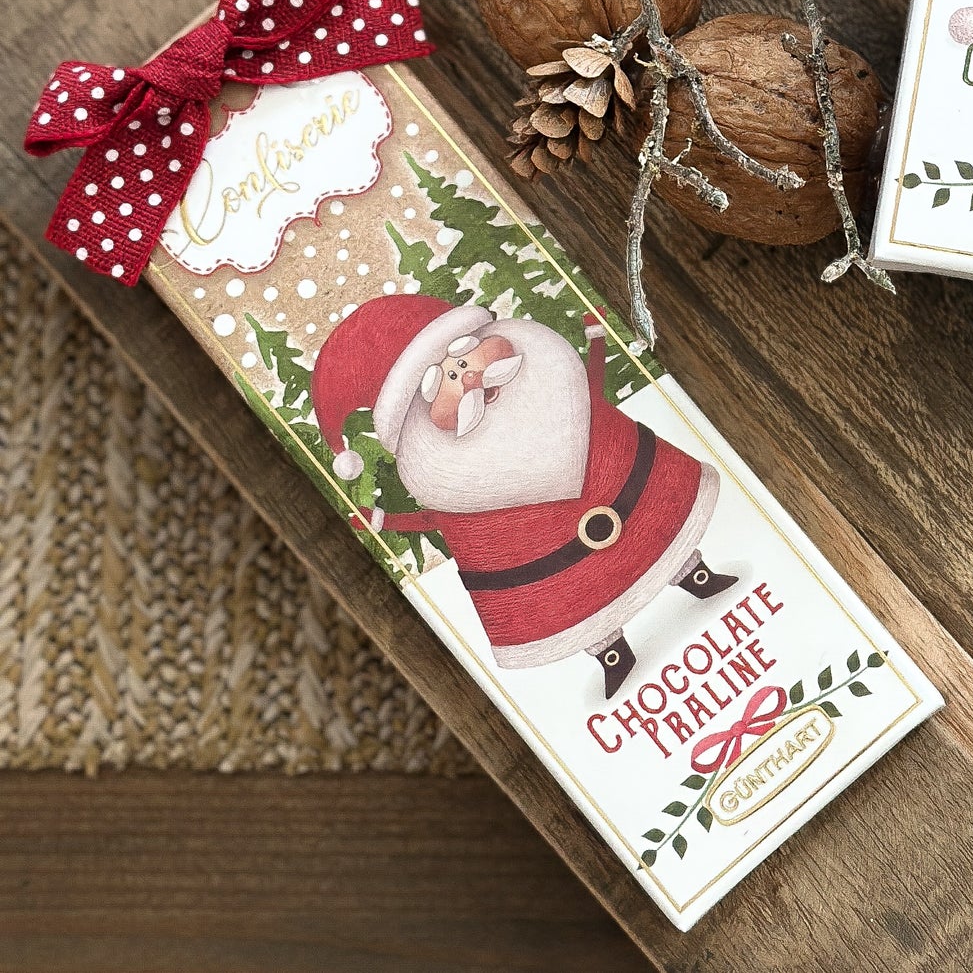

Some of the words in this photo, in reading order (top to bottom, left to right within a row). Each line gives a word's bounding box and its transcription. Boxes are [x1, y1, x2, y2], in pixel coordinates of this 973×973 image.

[168, 89, 361, 253] Confiserie
[586, 582, 784, 754] CHOCOLATE
[639, 638, 777, 759] PRALINE
[718, 717, 822, 814] GÜNTHART
